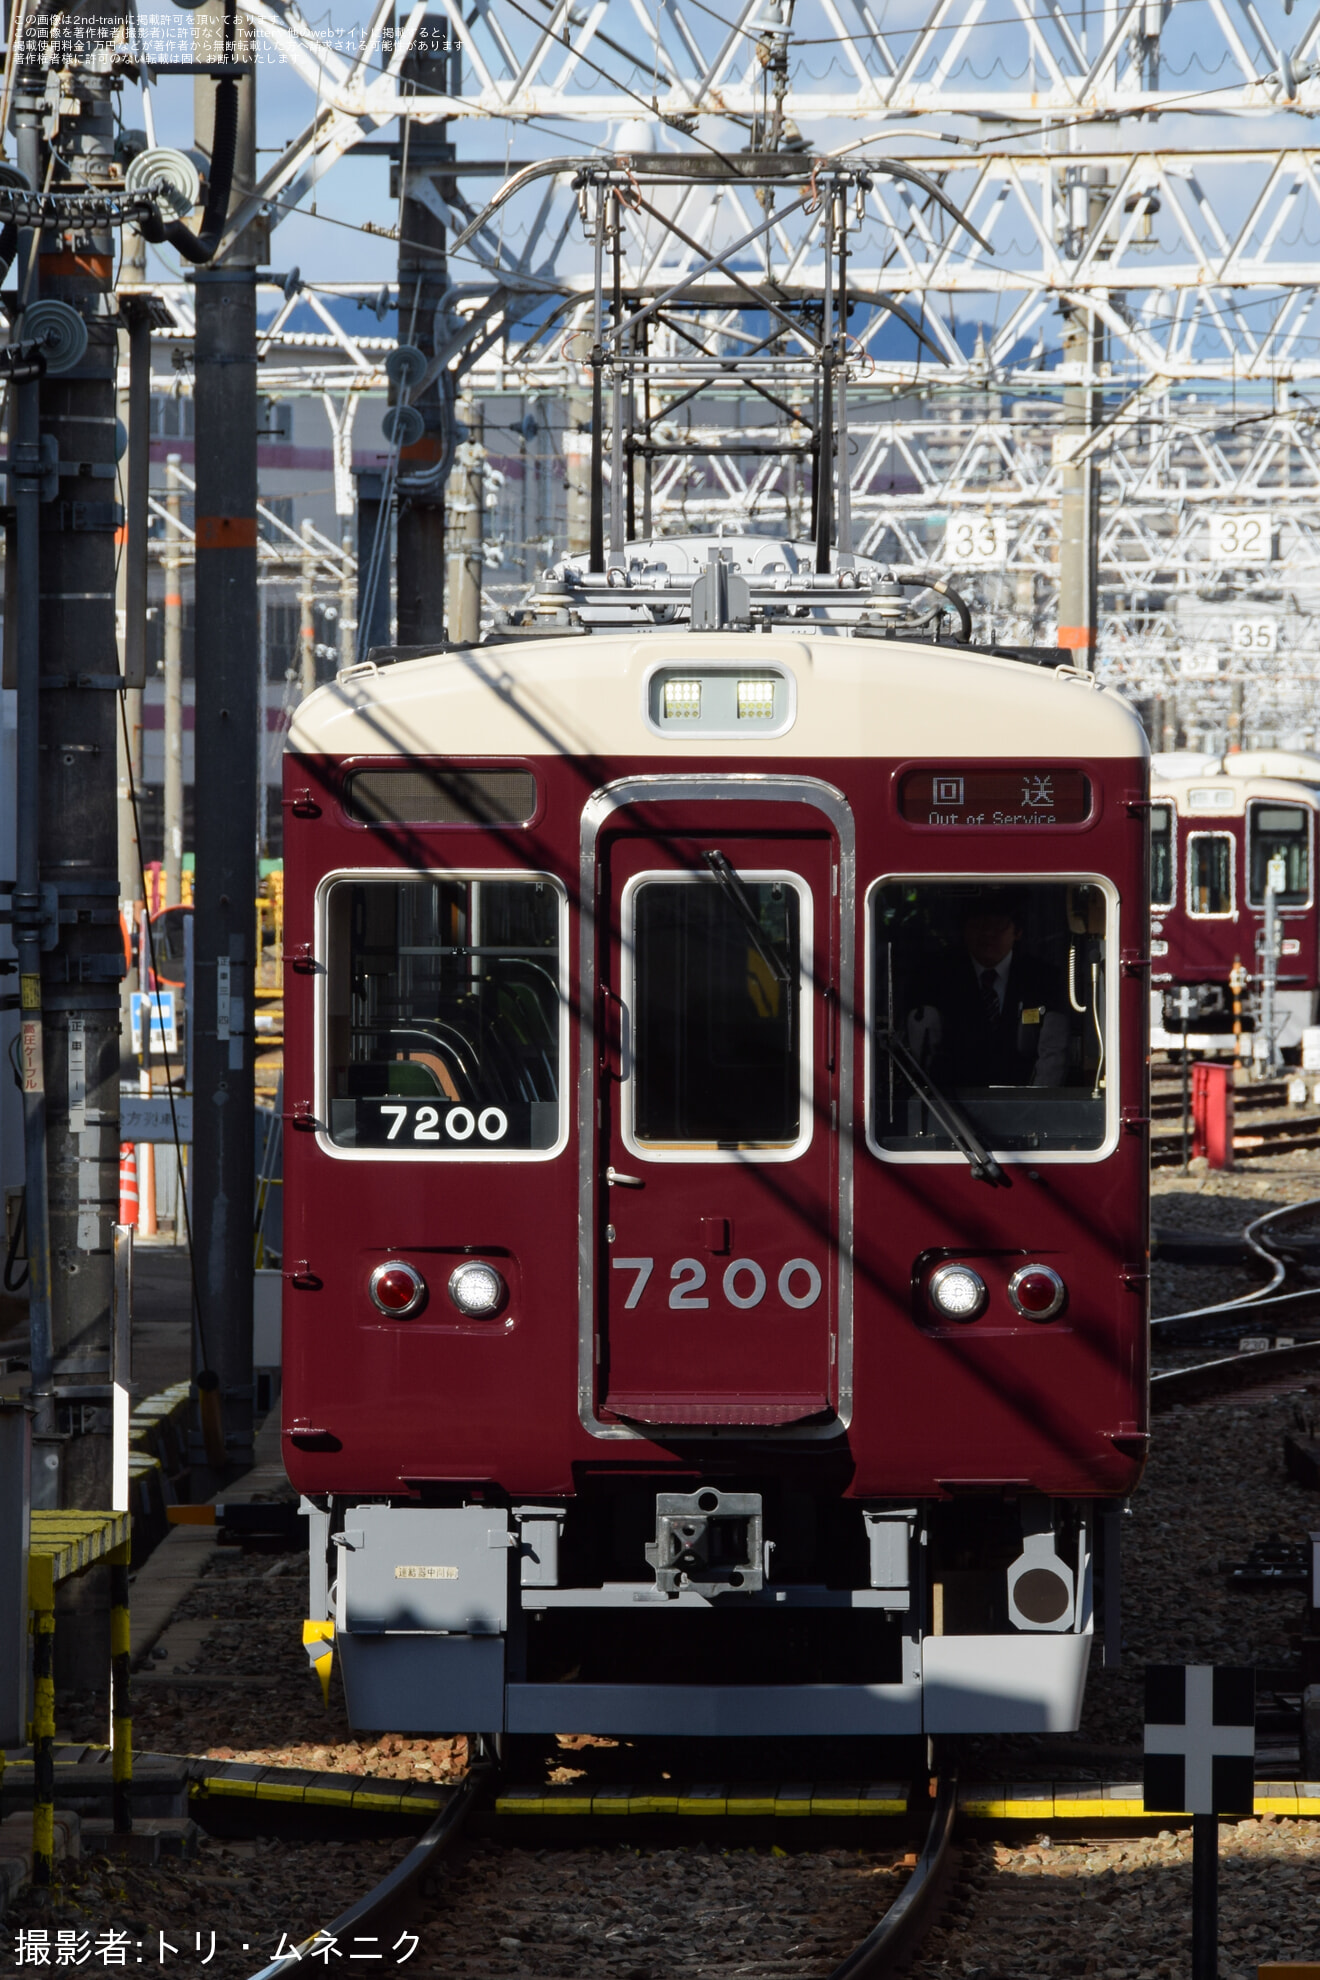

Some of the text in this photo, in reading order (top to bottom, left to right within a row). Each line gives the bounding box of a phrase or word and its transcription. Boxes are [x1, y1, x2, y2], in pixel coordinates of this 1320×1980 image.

[955, 523, 998, 559] 33
[1219, 520, 1262, 552] 32
[1238, 624, 1271, 648] 35
[928, 811, 1056, 825] Out of Service
[23, 1023, 38, 1090] 高圧ケーブル
[380, 1105, 508, 1141] 7200
[612, 1257, 822, 1310] 7200
